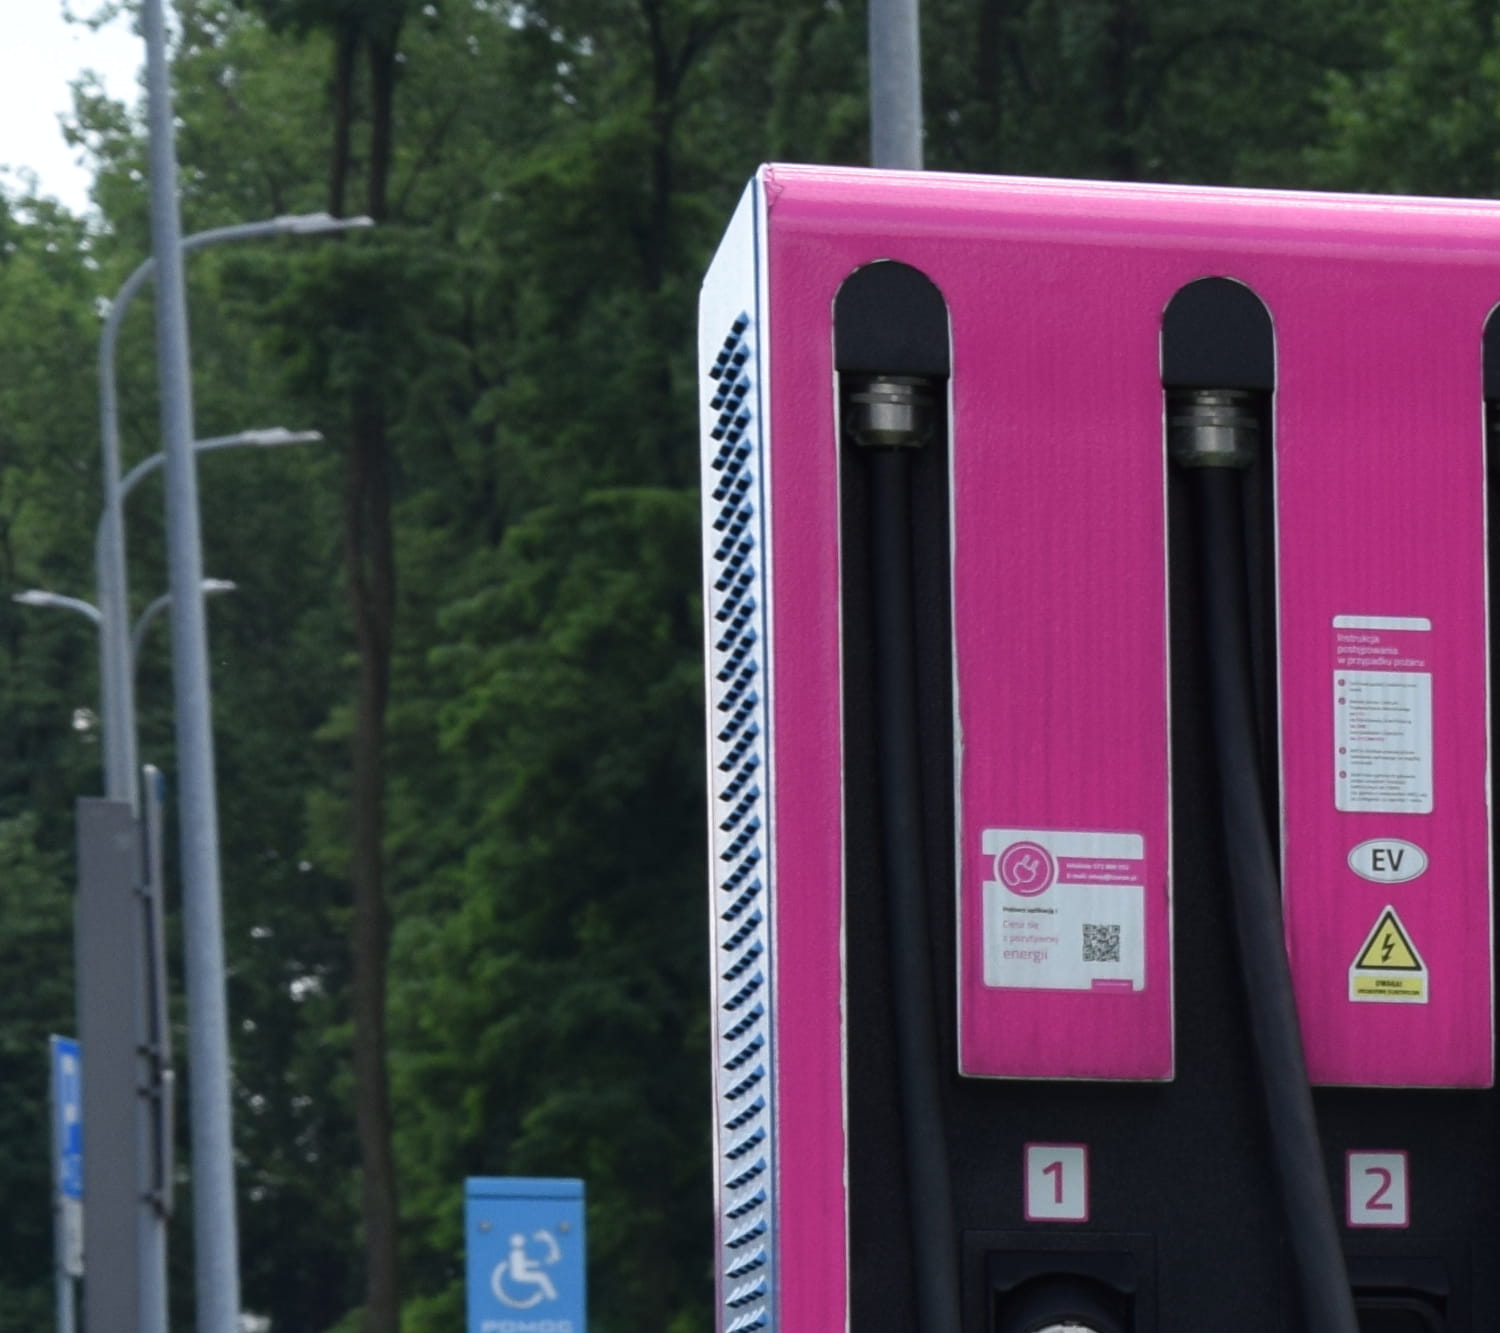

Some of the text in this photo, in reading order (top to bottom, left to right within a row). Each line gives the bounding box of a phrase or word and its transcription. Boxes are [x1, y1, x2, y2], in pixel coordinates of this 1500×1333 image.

[1371, 848, 1404, 872] EV
[1003, 949, 1048, 964] energii
[1041, 1160, 1064, 1205] 1
[1364, 1166, 1394, 1211] 2
